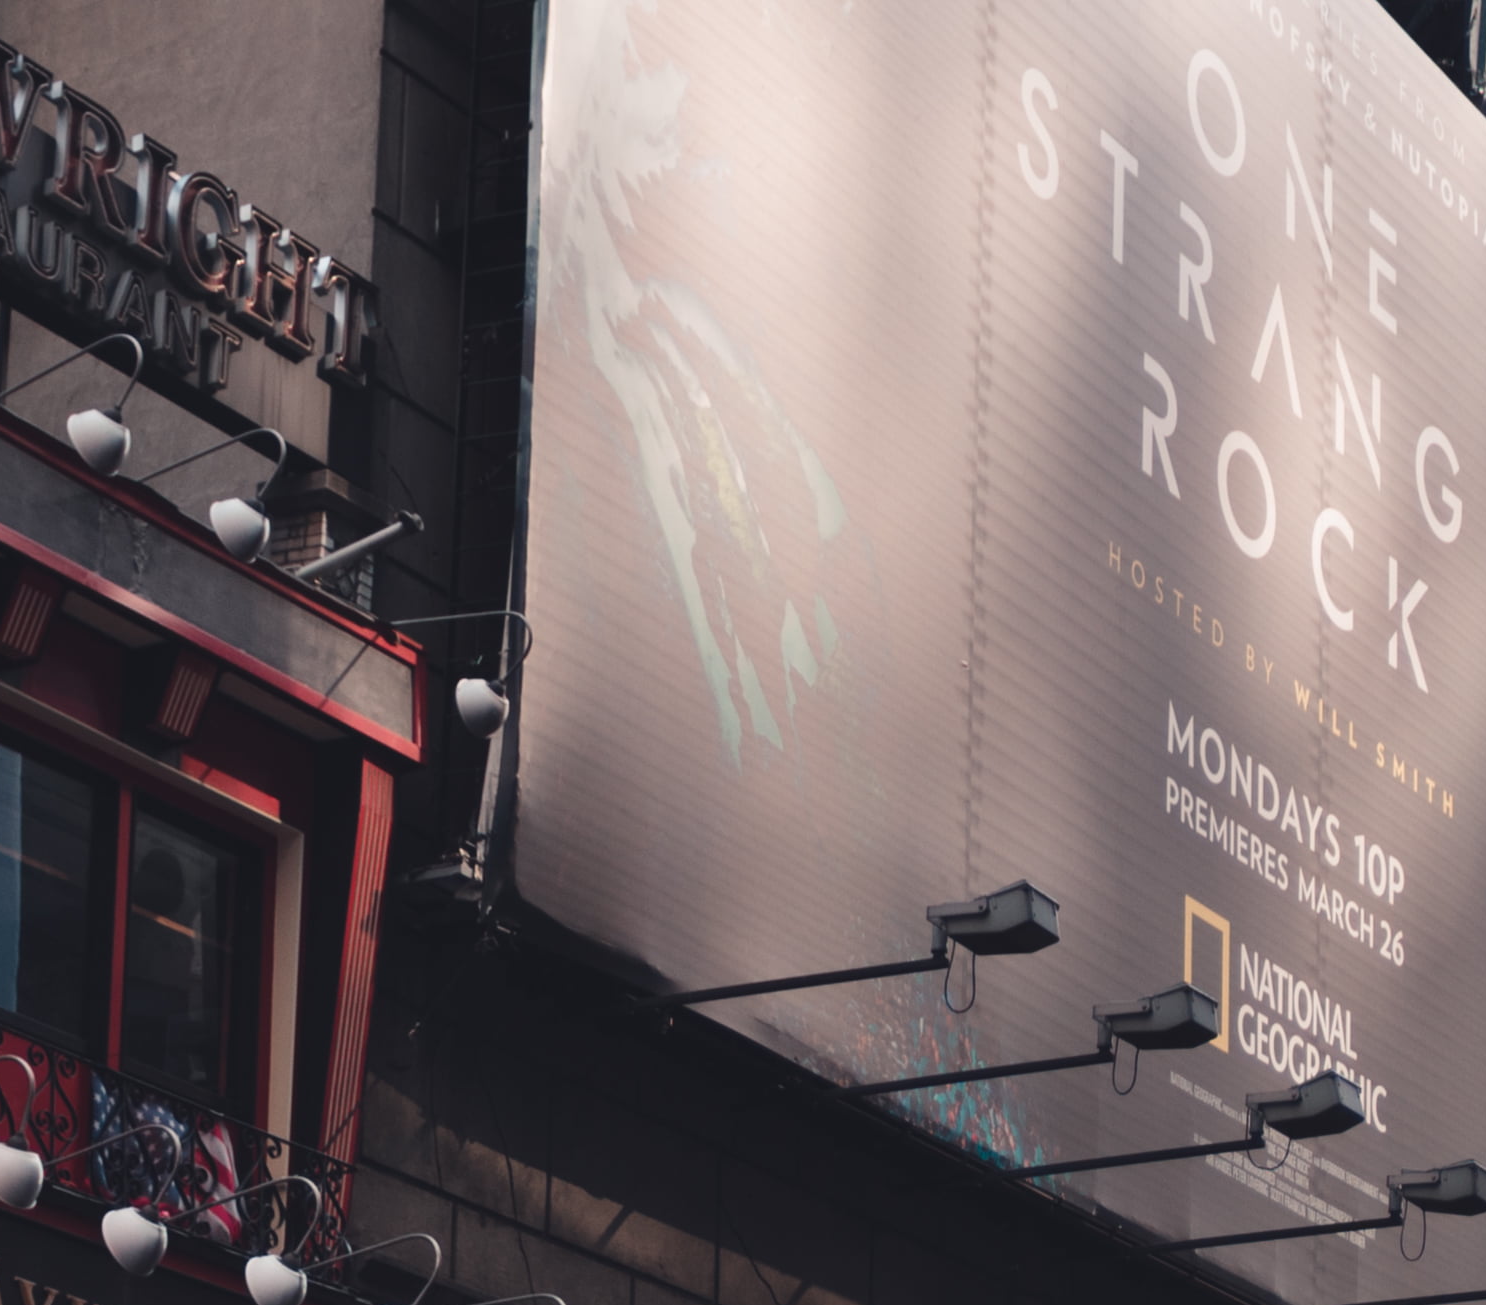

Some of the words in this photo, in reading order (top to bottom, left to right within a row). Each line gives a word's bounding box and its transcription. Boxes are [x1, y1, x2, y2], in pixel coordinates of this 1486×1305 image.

[1400, 79, 1465, 165] FROM
[1108, 540, 1225, 648] HOSTED
[1245, 643, 1275, 685] BY
[1294, 680, 1358, 749] WILL
[1376, 742, 1455, 818] SMITH
[1165, 775, 1289, 891] PREMIERES
[1298, 866, 1375, 949] MARCH
[1378, 919, 1405, 967] 26
[1167, 700, 1341, 867] MONDAYS
[1354, 834, 1405, 905] 10P
[1240, 943, 1358, 1061] NATIONAL
